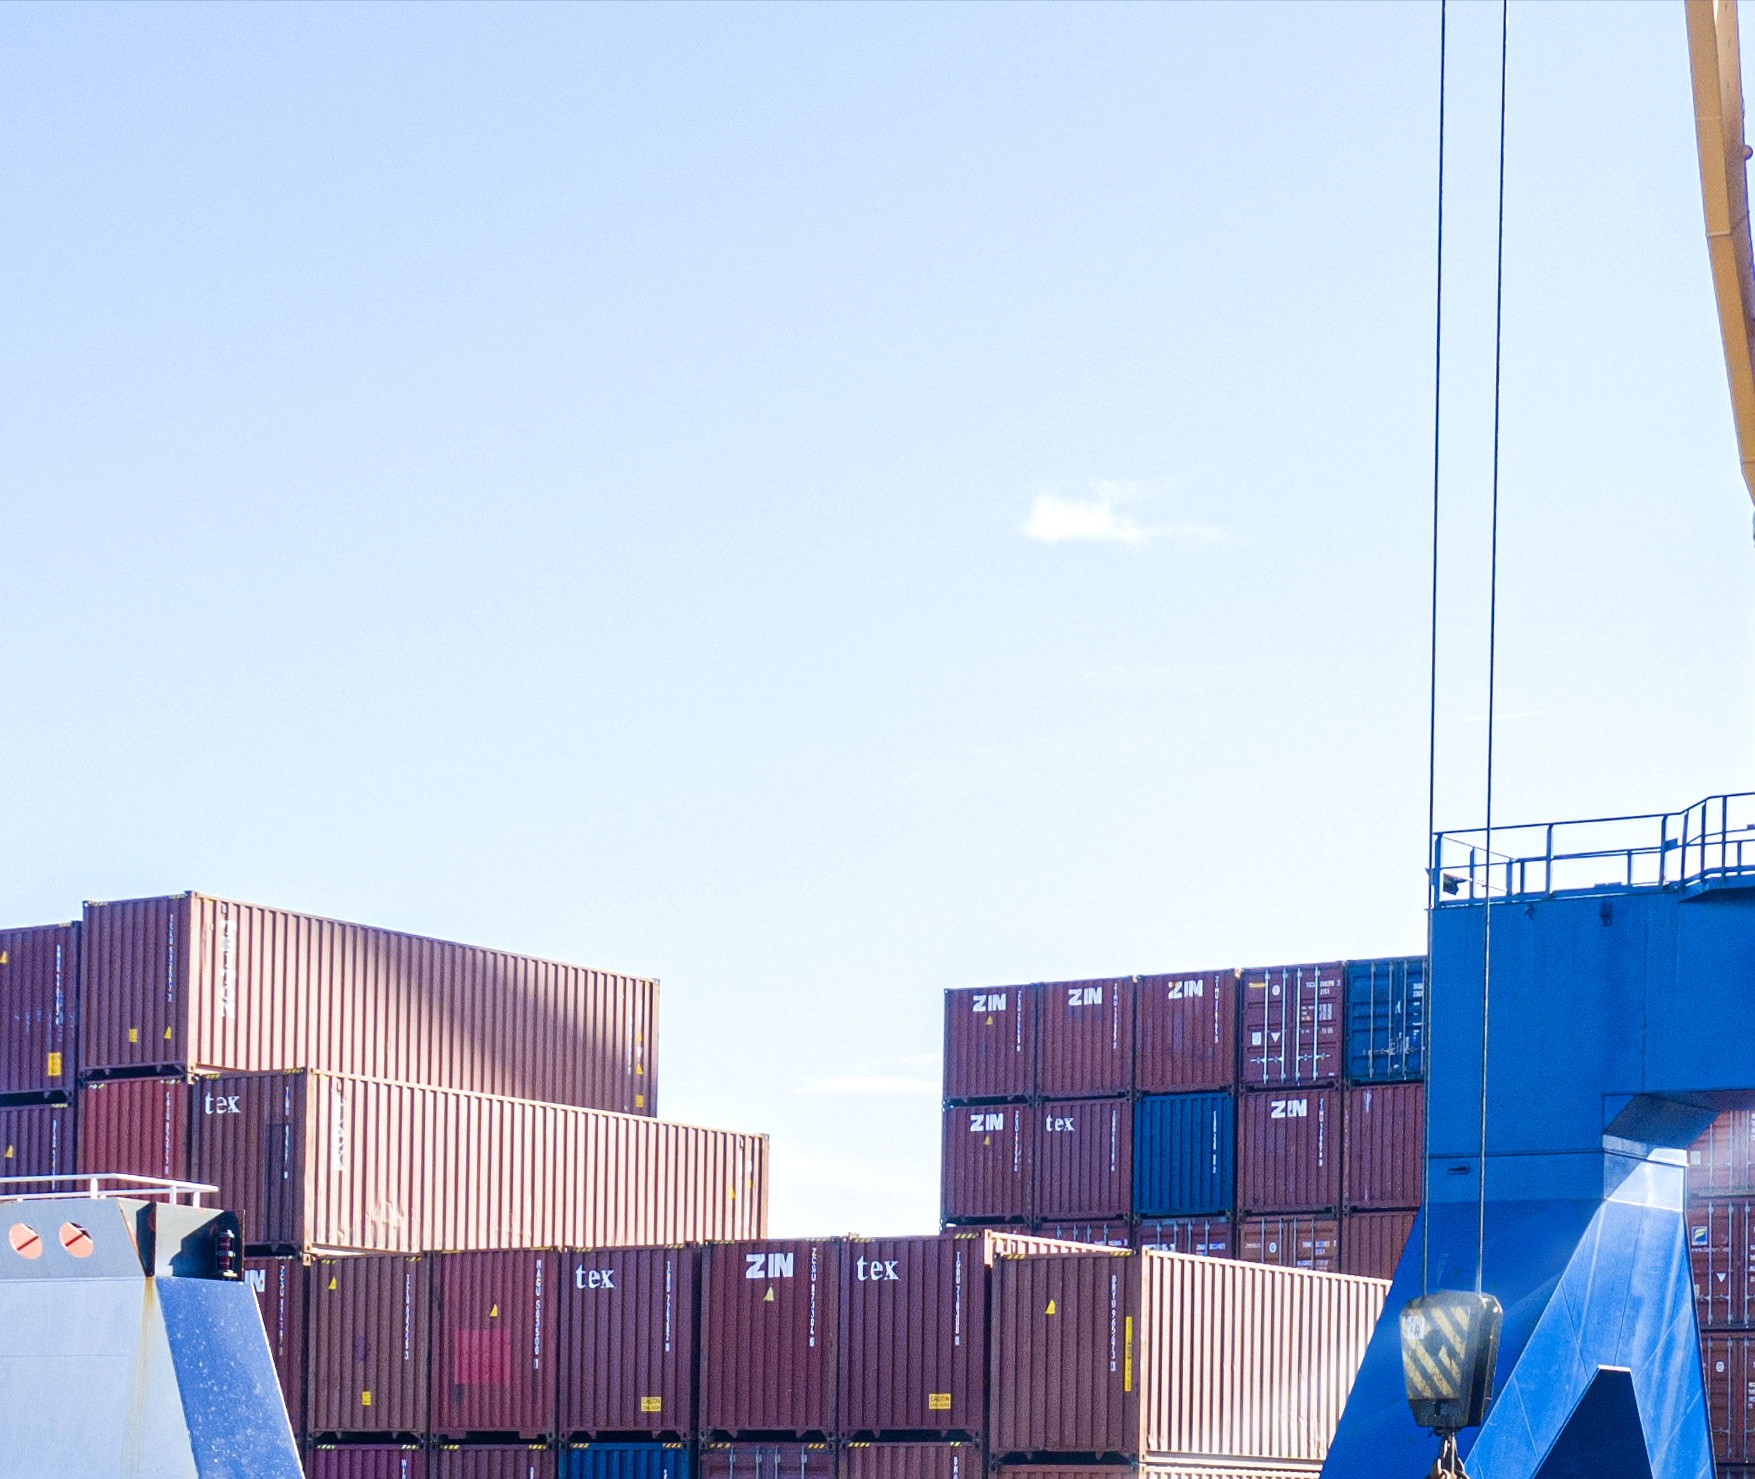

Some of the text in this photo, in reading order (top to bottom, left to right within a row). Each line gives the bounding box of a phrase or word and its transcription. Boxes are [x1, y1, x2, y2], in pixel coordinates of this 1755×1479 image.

[1067, 986, 1103, 1006] ZIM
[1167, 979, 1203, 1000] ZIM
[972, 993, 1007, 1013] ZIM
[204, 1091, 242, 1115] tex
[1270, 1098, 1308, 1119] ZIM
[969, 1112, 1004, 1132] ZIM
[1045, 1114, 1075, 1132] tex
[745, 1252, 794, 1279] ZIM
[856, 1255, 900, 1281] tex
[575, 1264, 615, 1290] tex
